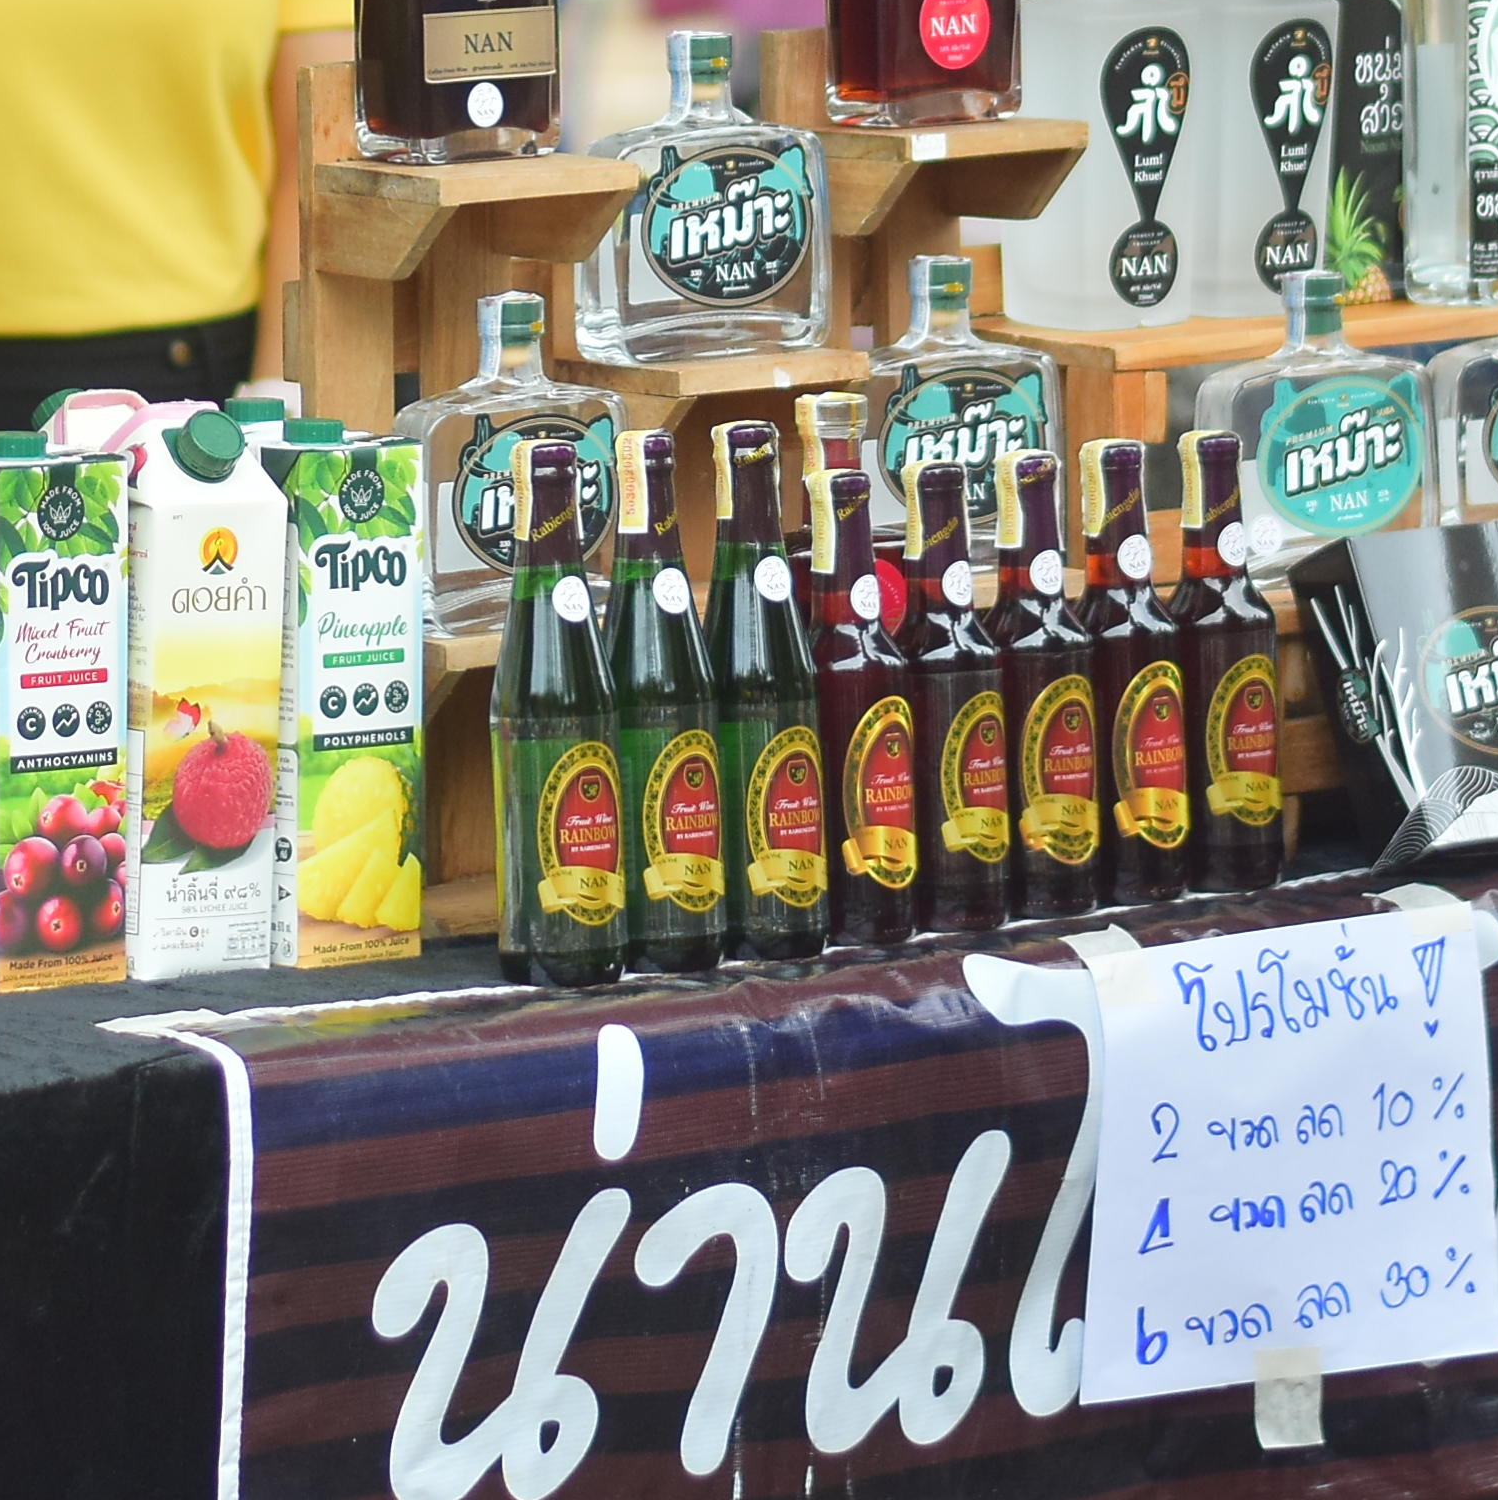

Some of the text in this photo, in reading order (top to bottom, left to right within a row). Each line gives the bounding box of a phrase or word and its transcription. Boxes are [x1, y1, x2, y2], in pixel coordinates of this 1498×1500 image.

[930, 14, 976, 37] NAN
[464, 31, 513, 54] NAN
[1281, 144, 1308, 157] Lum!
[1135, 154, 1163, 167] Lum!
[1280, 160, 1307, 172] Khue!
[1135, 170, 1163, 182] Khue!
[671, 192, 721, 211] PREMIUM
[1265, 243, 1309, 266] NAN
[715, 262, 755, 282] NAN
[1121, 254, 1168, 277] NAN
[907, 414, 956, 429] PREMIUM
[1285, 425, 1333, 445] PREMIUM
[341, 470, 382, 491] MADE FROM
[41, 485, 82, 509] MADE FROM
[1330, 490, 1367, 512] NAN
[360, 502, 379, 520] JUICE
[60, 519, 80, 538] JUICE
[172, 578, 267, 614] ดอยคำ
[15, 618, 109, 645] Mixed Fruit
[318, 612, 408, 646] Pineapple
[25, 644, 101, 666] Cranberry
[333, 651, 395, 665] FRUIT JUICE
[30, 671, 98, 686] FRUIT JUICE
[323, 687, 344, 698] VITAMIN
[328, 696, 338, 710] C
[20, 708, 43, 719] VITAMIN
[26, 717, 37, 731] C
[324, 731, 406, 746] POLYPHENOLS
[17, 752, 113, 769] ANTHOCYANINS
[1044, 755, 1092, 773] RAINBOW
[1245, 781, 1270, 793] NAN
[671, 803, 696, 814] Fruit
[775, 798, 799, 810] Fruit
[1062, 803, 1087, 815] NAN
[1155, 798, 1178, 811] NAN
[566, 813, 613, 826] Fruit Wine
[665, 812, 718, 831] RAINBOW
[769, 807, 820, 827] RAINBOW
[981, 816, 1002, 829] NAN
[560, 825, 615, 844] RAINBOW
[884, 837, 908, 851] NAN
[684, 863, 711, 876] NAN
[788, 858, 814, 871] NAN
[166, 876, 261, 902] น้ำลิ้นจี่ ๙๘%
[580, 876, 608, 889] NAN
[200, 903, 226, 912] LYCHEE
[229, 902, 247, 911] JUICE
[313, 936, 409, 954] Made From 100% Juice
[9, 953, 113, 970] Made From 100% Juice
[1173, 923, 1398, 1051] โปรโมชั่น
[1151, 1072, 1466, 1163] 2 ขวด ลด 10 %
[1210, 1195, 1286, 1233] ขวด
[1300, 1182, 1353, 1224] ลด
[1380, 1160, 1416, 1206] 20
[1433, 1150, 1470, 1199] %
[1136, 1247, 1475, 1365] 6 ขวด ลด 30 %
